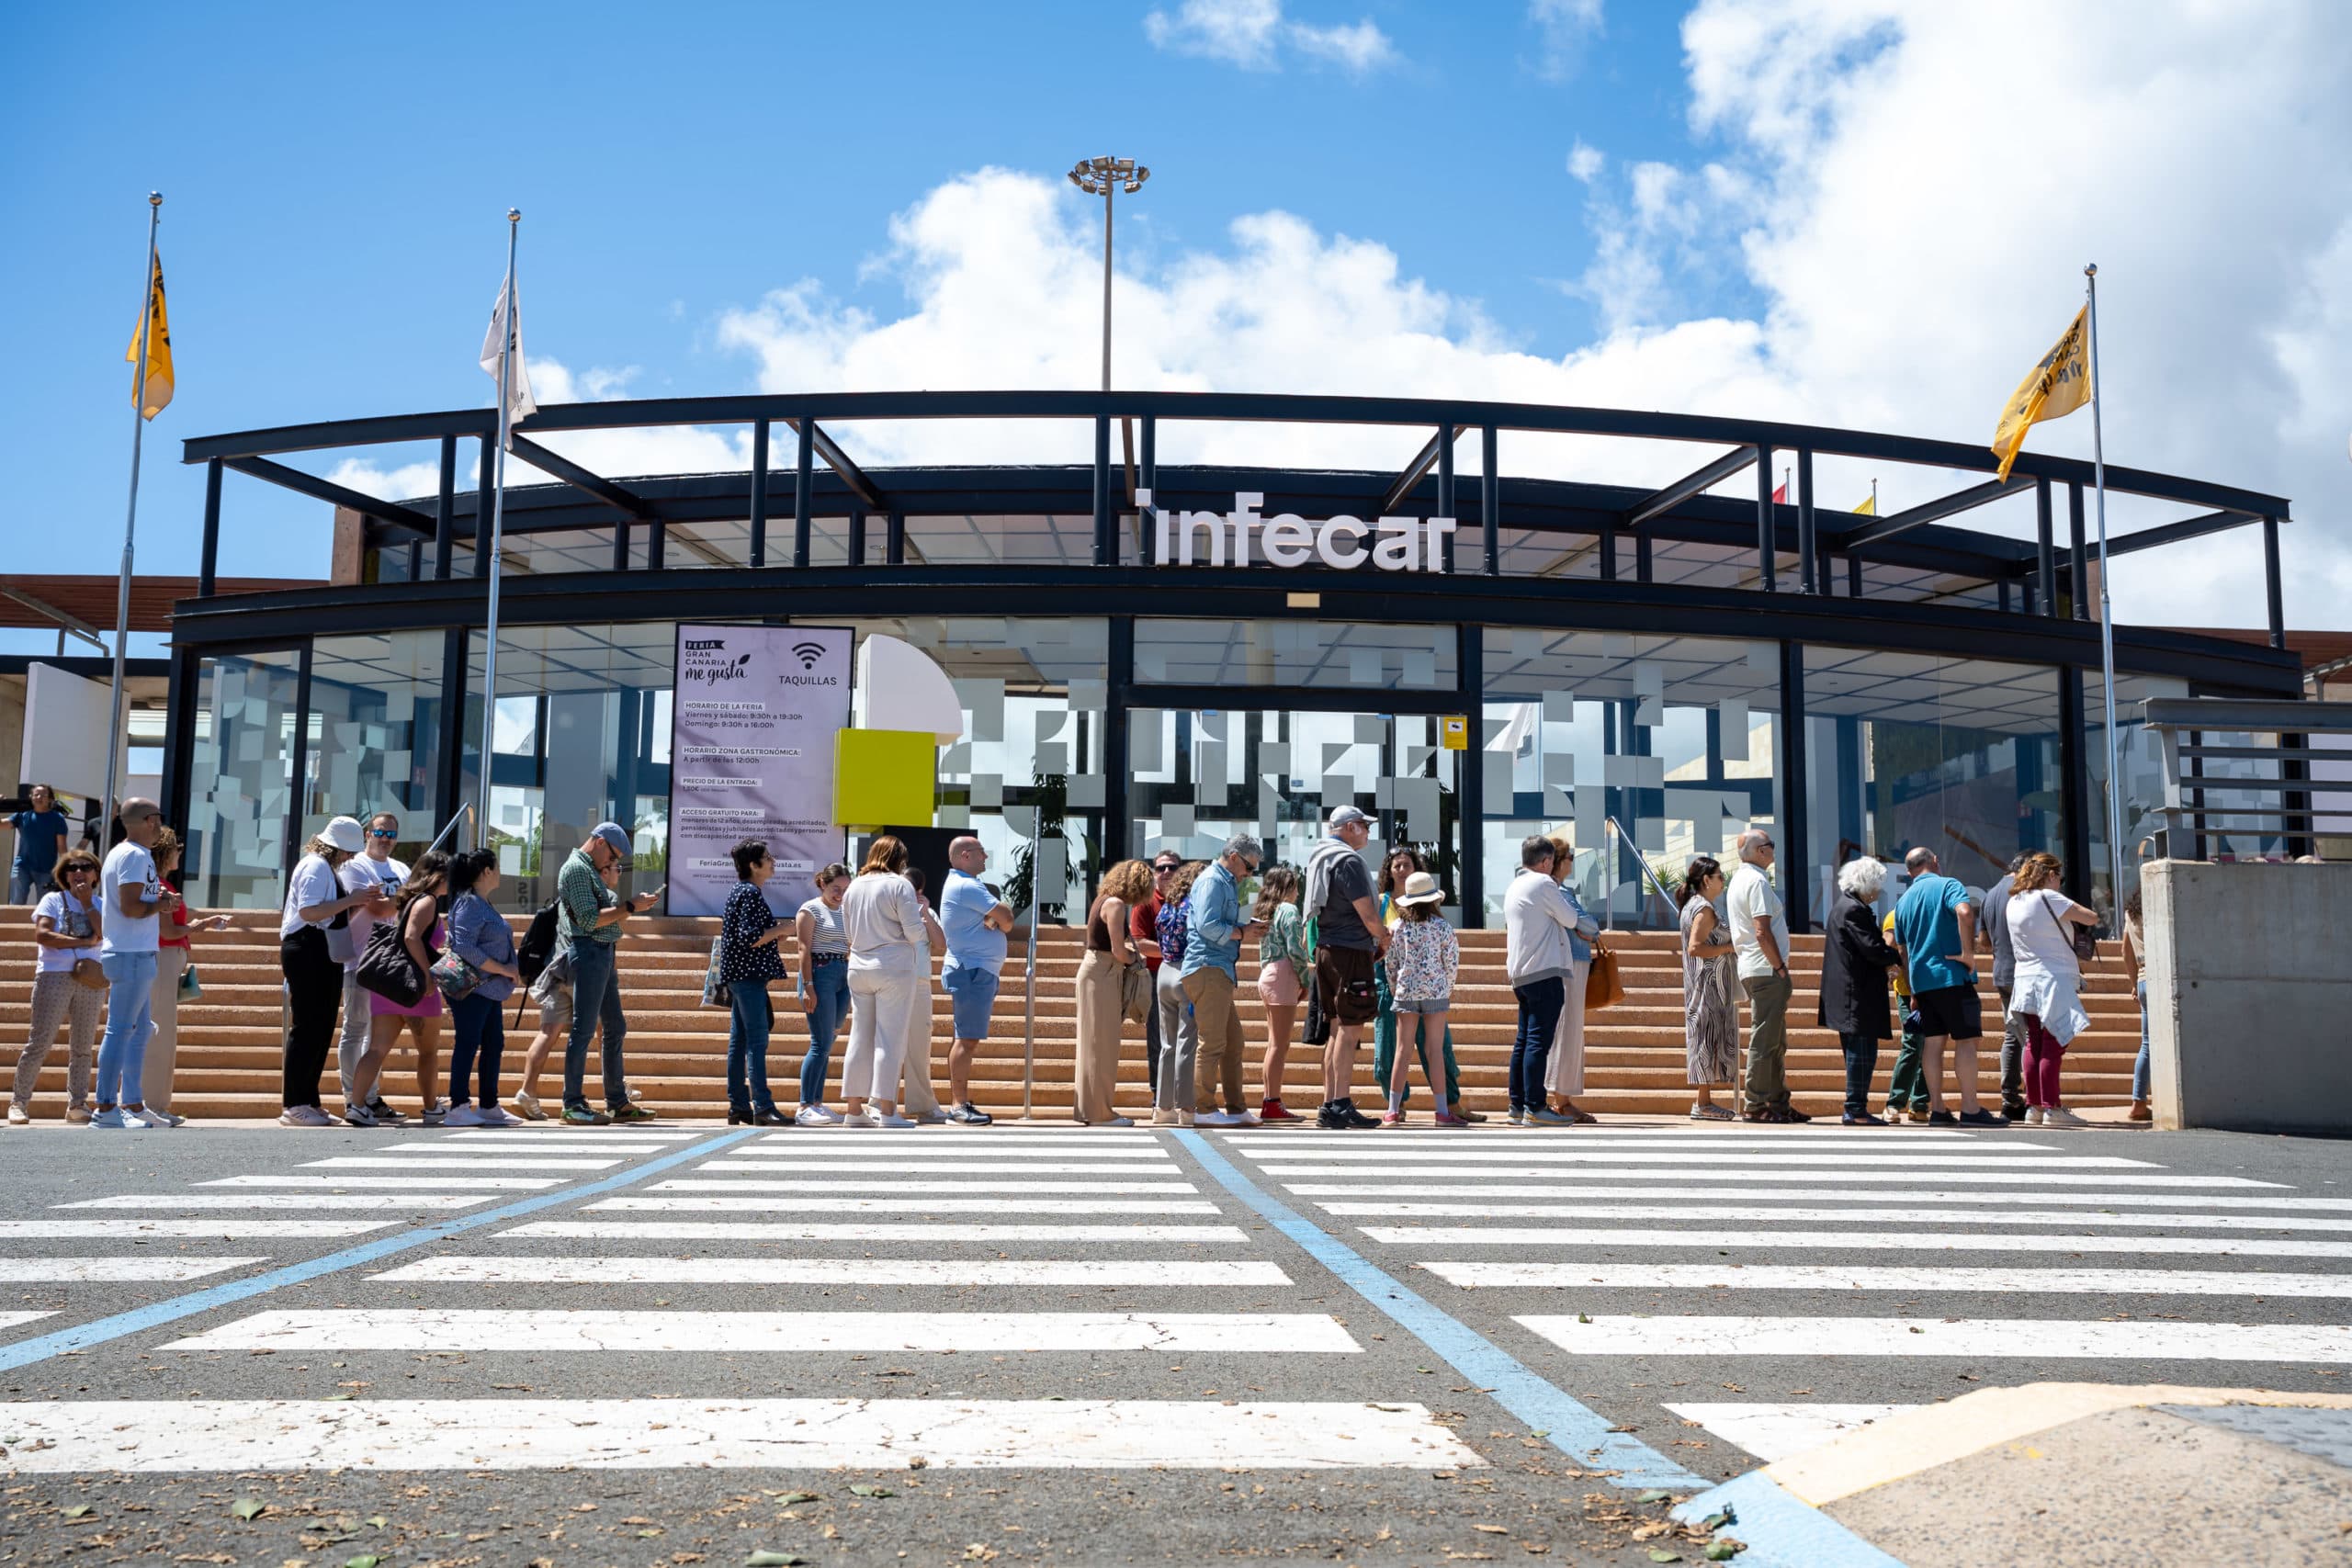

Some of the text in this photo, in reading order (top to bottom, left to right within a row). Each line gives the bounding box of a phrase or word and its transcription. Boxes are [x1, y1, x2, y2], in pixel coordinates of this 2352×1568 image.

[1136, 489, 1456, 572] infecar
[687, 641, 716, 649] FERIA
[685, 660, 748, 686] me gusta
[779, 675, 838, 686] TAQUILLAS
[684, 711, 713, 719] Viernes
[719, 711, 749, 719] sábado:
[779, 713, 803, 721] 19:30h
[684, 720, 720, 729] Domingo:
[740, 747, 801, 756] GASTRONÓMICA:
[693, 832, 737, 840] discapacidad
